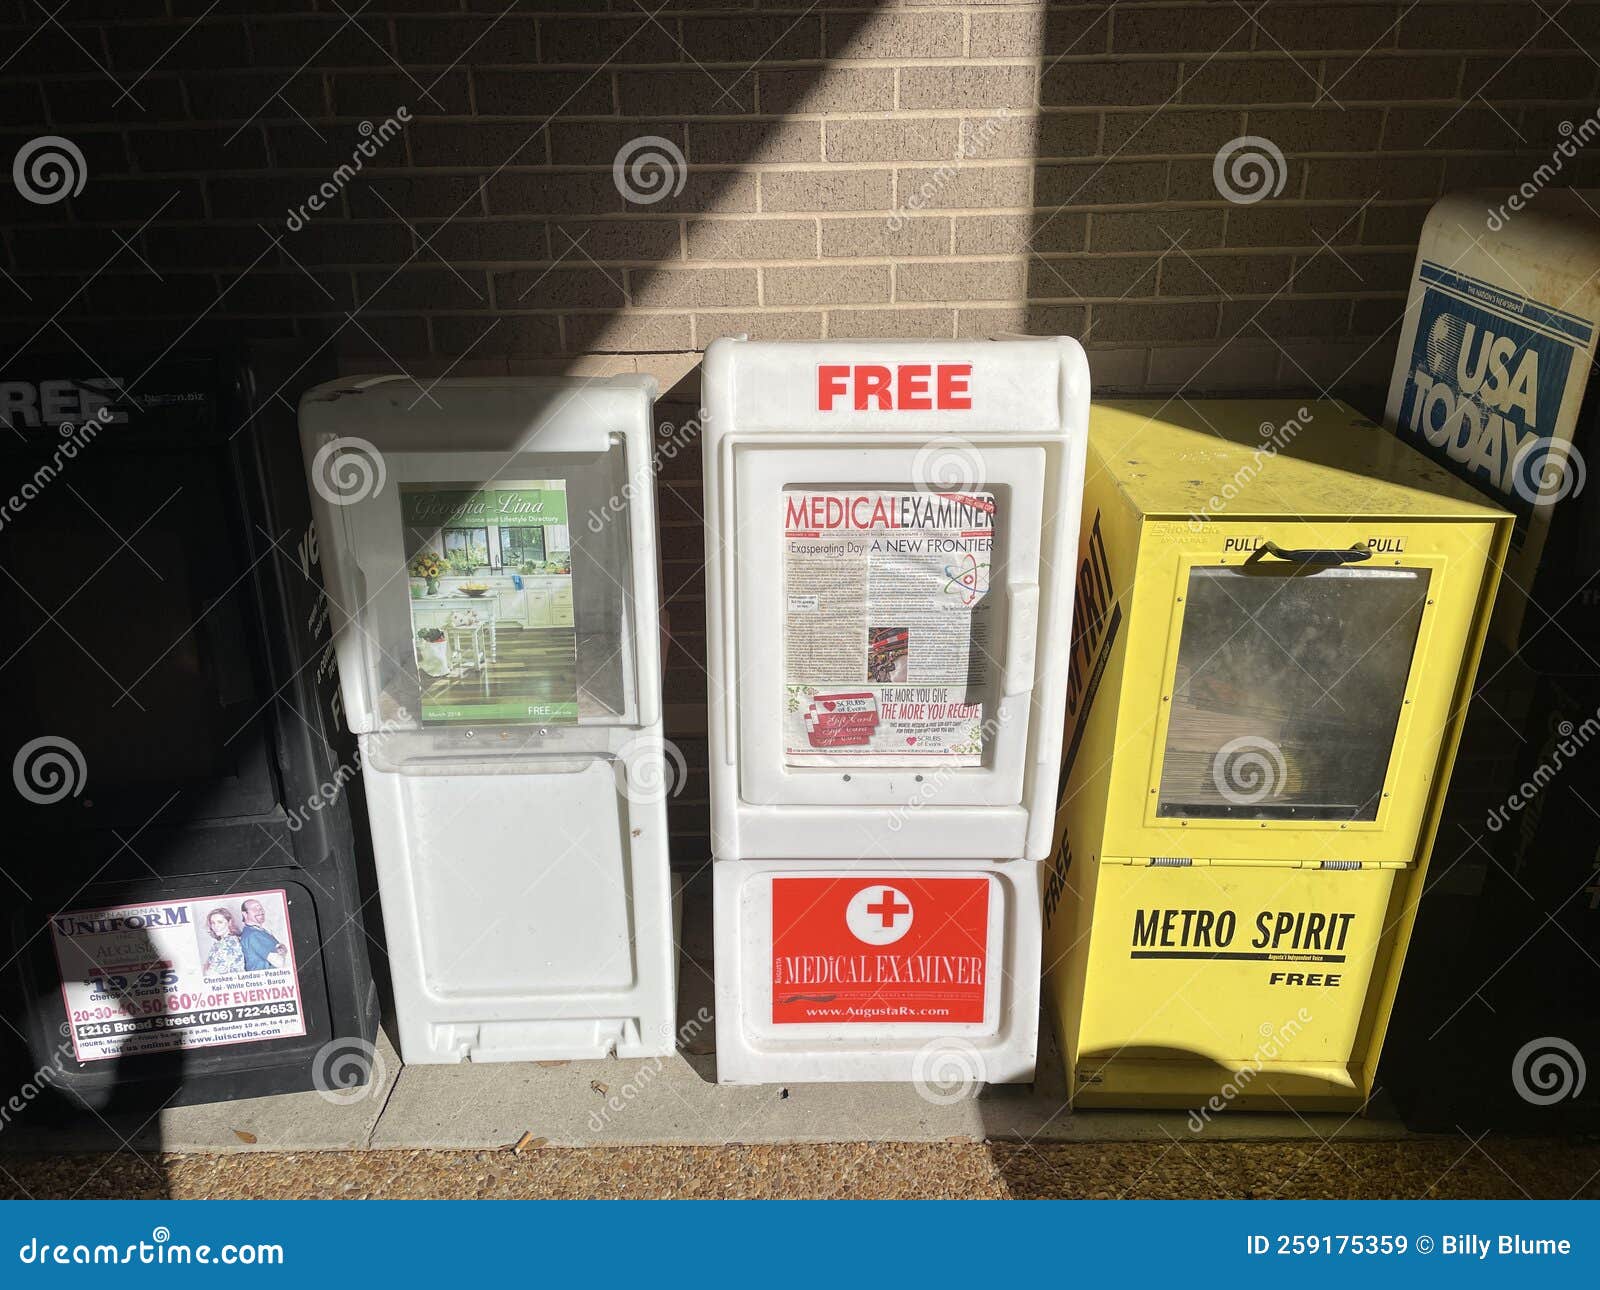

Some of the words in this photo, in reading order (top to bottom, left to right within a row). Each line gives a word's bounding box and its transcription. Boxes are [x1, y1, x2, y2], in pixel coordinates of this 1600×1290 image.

[1457, 322, 1539, 428] USA
[818, 364, 973, 411] FREE
[1410, 371, 1539, 496] TODAY
[528, 514, 559, 524] Directory
[847, 541, 864, 554] Day
[870, 539, 881, 552] A
[886, 539, 923, 553] NEW
[927, 538, 994, 553] FRONTIER
[1225, 538, 1260, 552] PULL
[1367, 538, 1404, 553] PULL
[881, 688, 893, 702] THE
[895, 688, 915, 703] MORE
[916, 688, 931, 703] YOU
[932, 688, 948, 703] GIVE
[528, 705, 551, 716] FREE
[881, 703, 897, 720] THE
[898, 704, 926, 720] MORE
[927, 703, 946, 720] YOU
[947, 702, 980, 719] RECEIVE
[1131, 909, 1237, 948] METRO
[1251, 911, 1356, 951] SPIRIT
[876, 954, 982, 985] EXAMINER
[1269, 972, 1342, 987] FREE
[207, 992, 230, 1007] OFF
[233, 984, 296, 1004] EVERYDAY
[78, 1023, 112, 1037] 1216
[199, 1009, 233, 1027] (706)
[235, 1003, 295, 1021] 722-4653
[806, 1006, 950, 1020] www.AugustaRx.com
